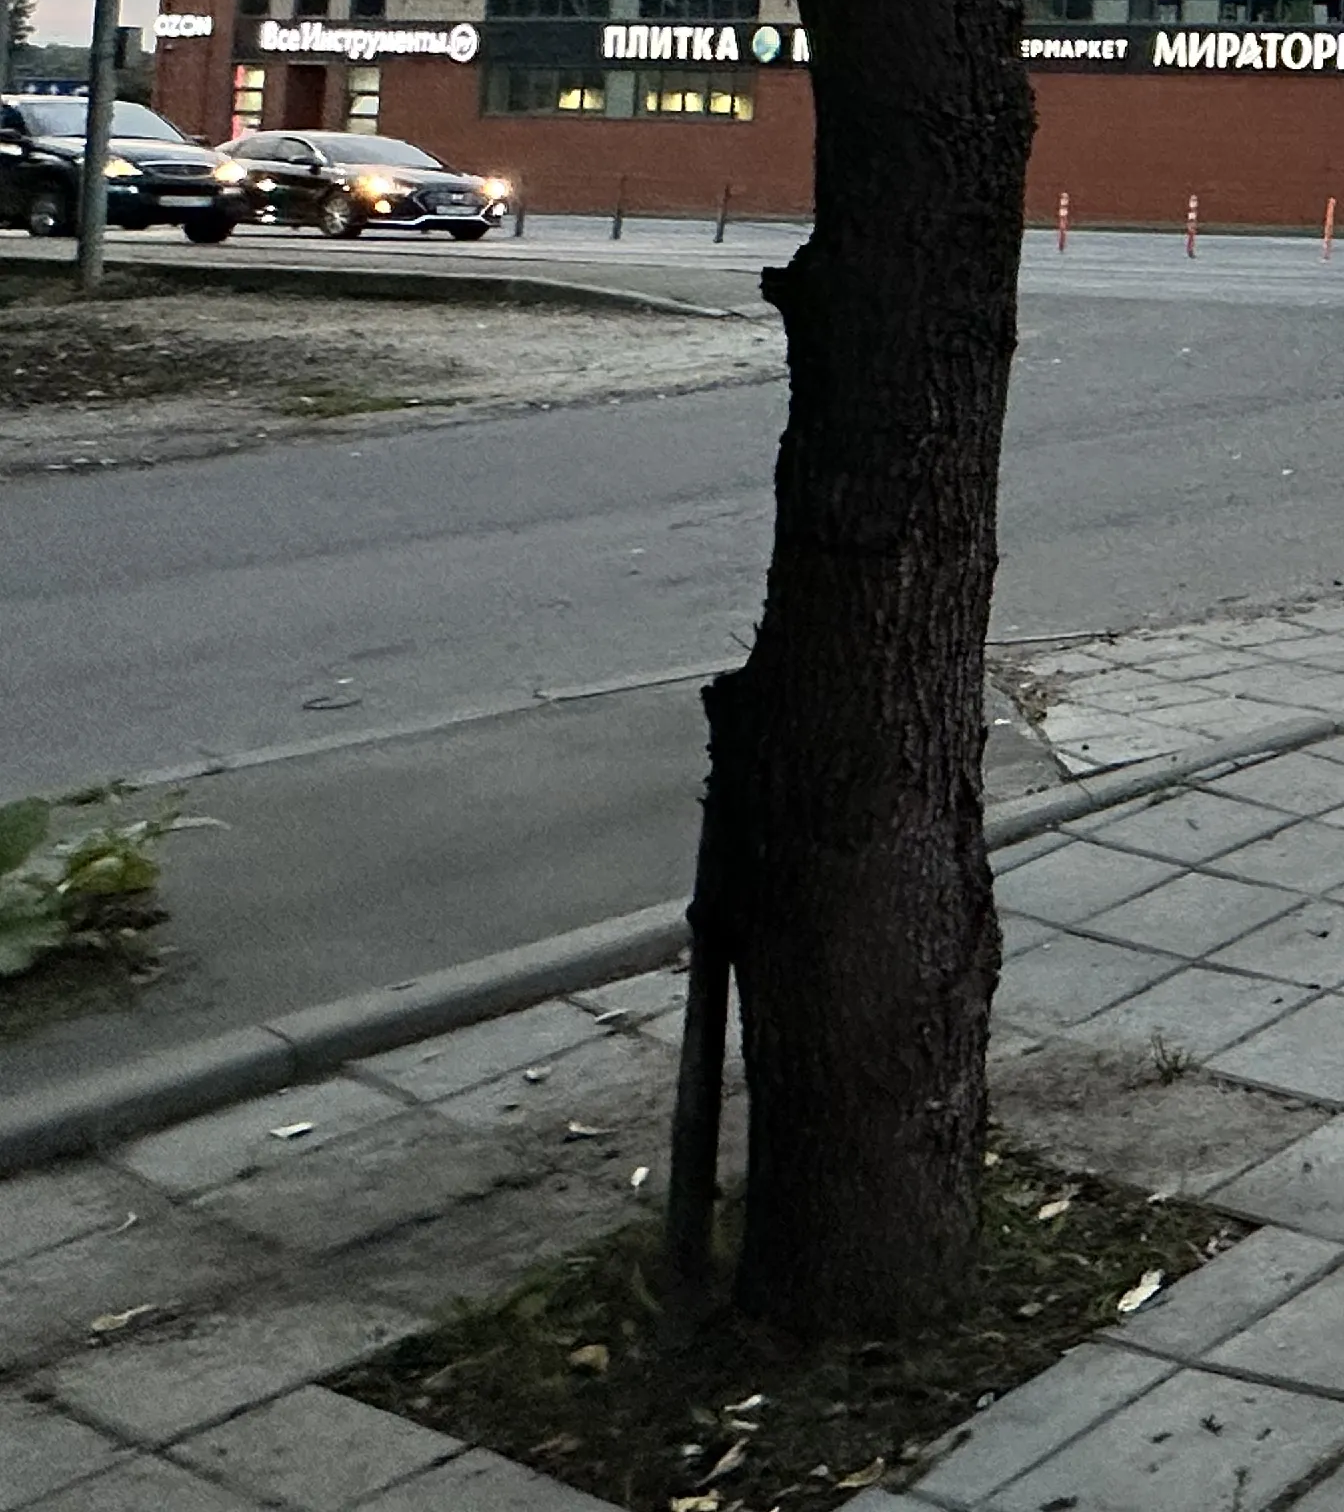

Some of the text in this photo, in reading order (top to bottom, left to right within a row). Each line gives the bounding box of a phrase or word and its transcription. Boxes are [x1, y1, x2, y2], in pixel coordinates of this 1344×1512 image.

[153, 13, 214, 37] OZON
[603, 24, 740, 61] ПЛИТКА
[1020, 38, 1129, 60] ЕРМАРКЕТ
